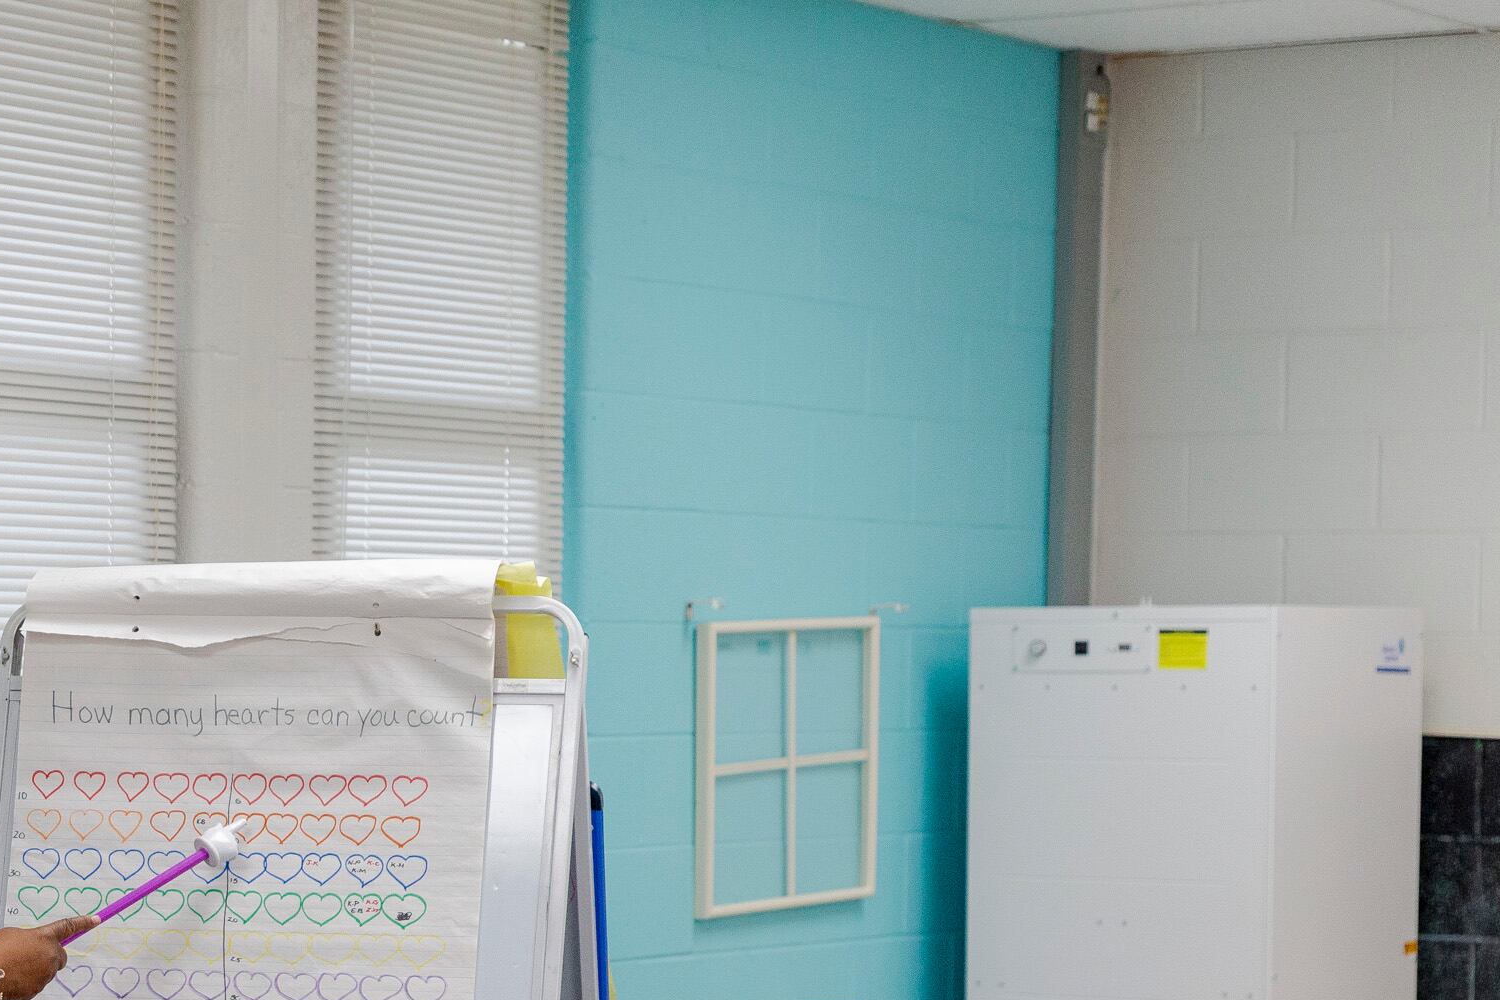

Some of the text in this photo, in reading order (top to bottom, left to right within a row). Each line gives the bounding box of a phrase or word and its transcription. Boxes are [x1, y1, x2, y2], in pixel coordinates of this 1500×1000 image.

[52, 690, 483, 737] How many hearts can you count
[17, 791, 28, 800] 10
[12, 831, 26, 839] 20
[7, 906, 19, 915] 40
